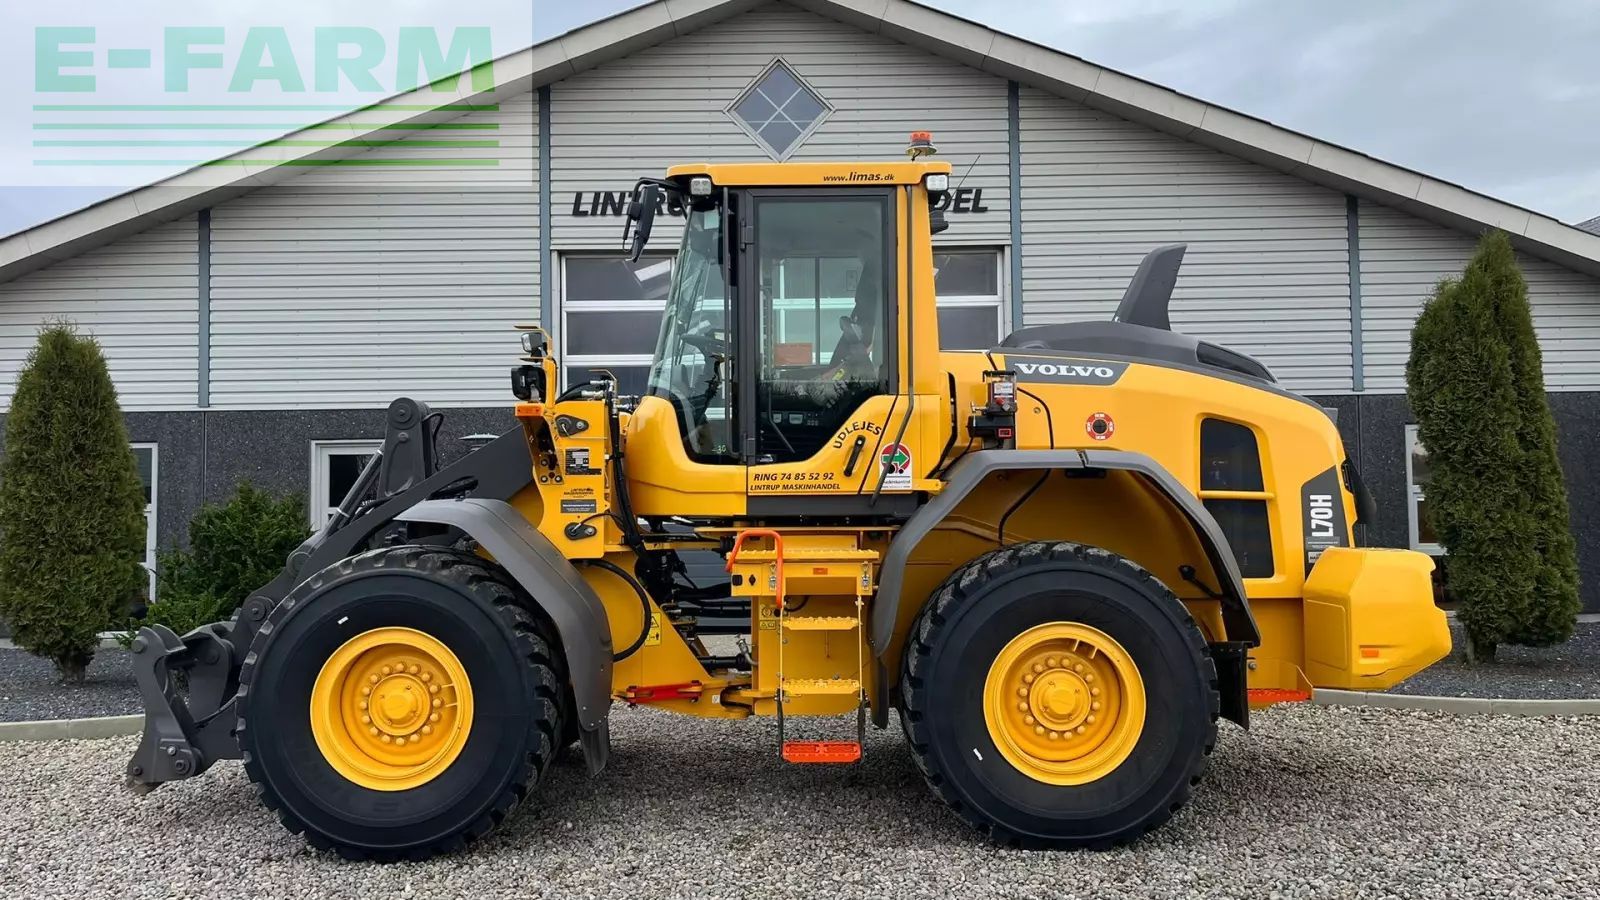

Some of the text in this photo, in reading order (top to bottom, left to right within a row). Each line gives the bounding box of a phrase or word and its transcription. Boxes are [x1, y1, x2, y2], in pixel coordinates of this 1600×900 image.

[823, 172, 895, 182] www.limas.dk
[1014, 363, 1114, 378] VOLVO
[832, 420, 882, 449] UDLEJES
[753, 472, 834, 481] RING 74 85 52 92
[782, 483, 841, 491] MASKINHANDEL
[1309, 494, 1334, 537] L70H
